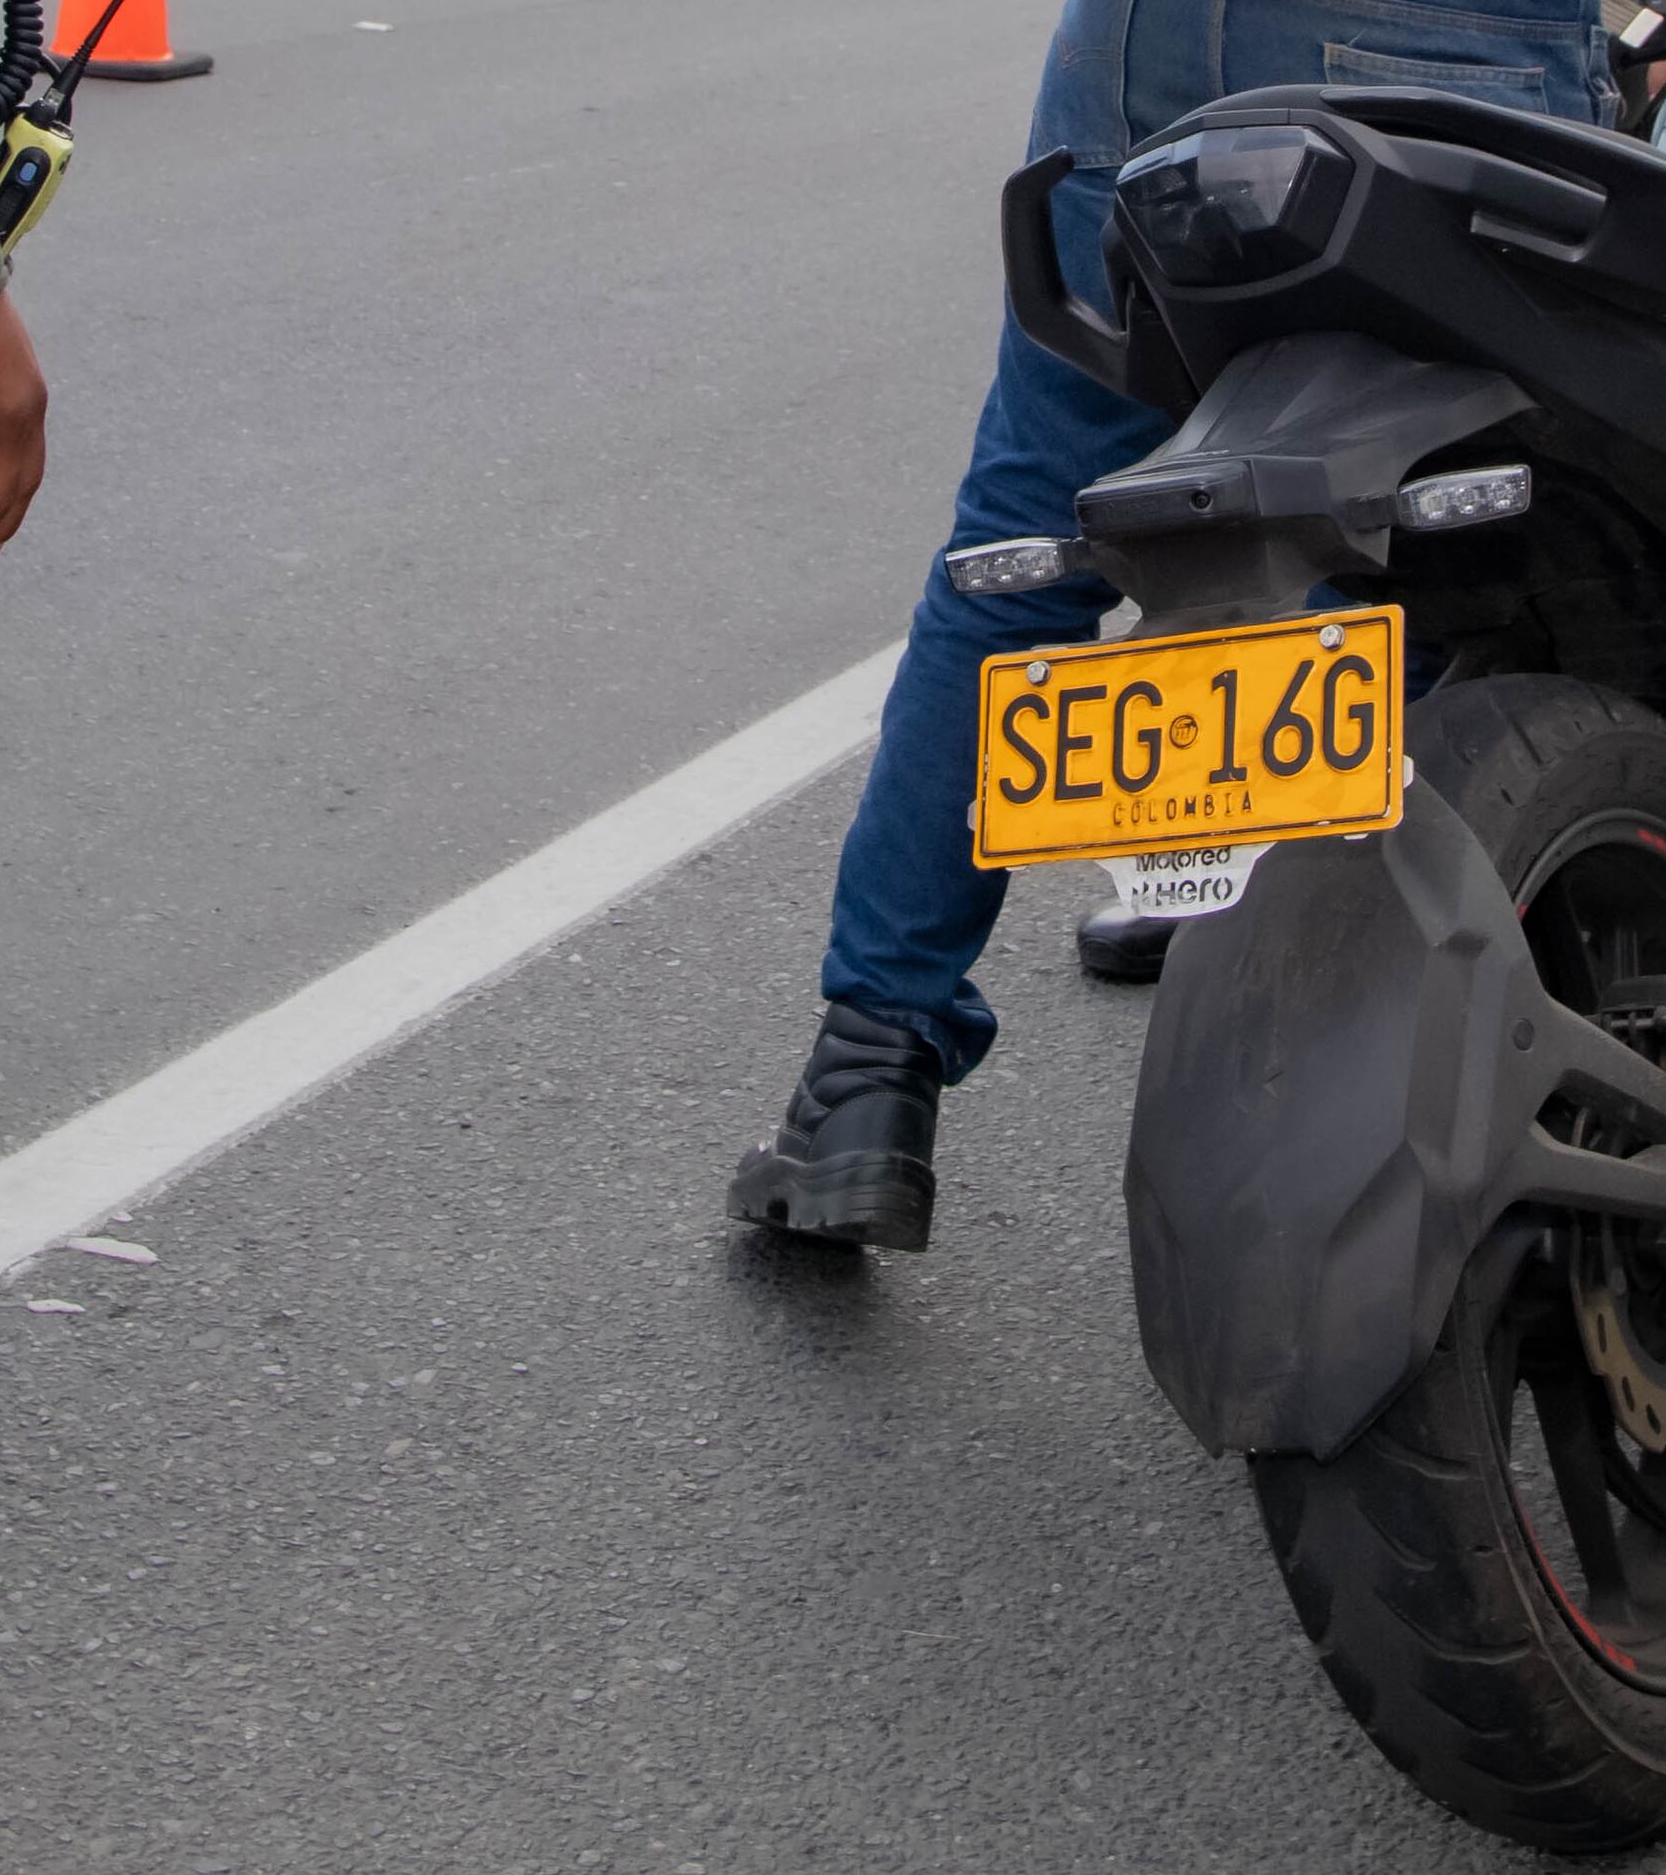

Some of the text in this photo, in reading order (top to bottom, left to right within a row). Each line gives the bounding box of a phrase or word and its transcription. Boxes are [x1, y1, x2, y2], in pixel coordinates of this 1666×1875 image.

[998, 655, 1375, 805] SEG 16G
[1113, 789, 1252, 825] COLOMBIA
[1155, 876, 1233, 907] Hero
